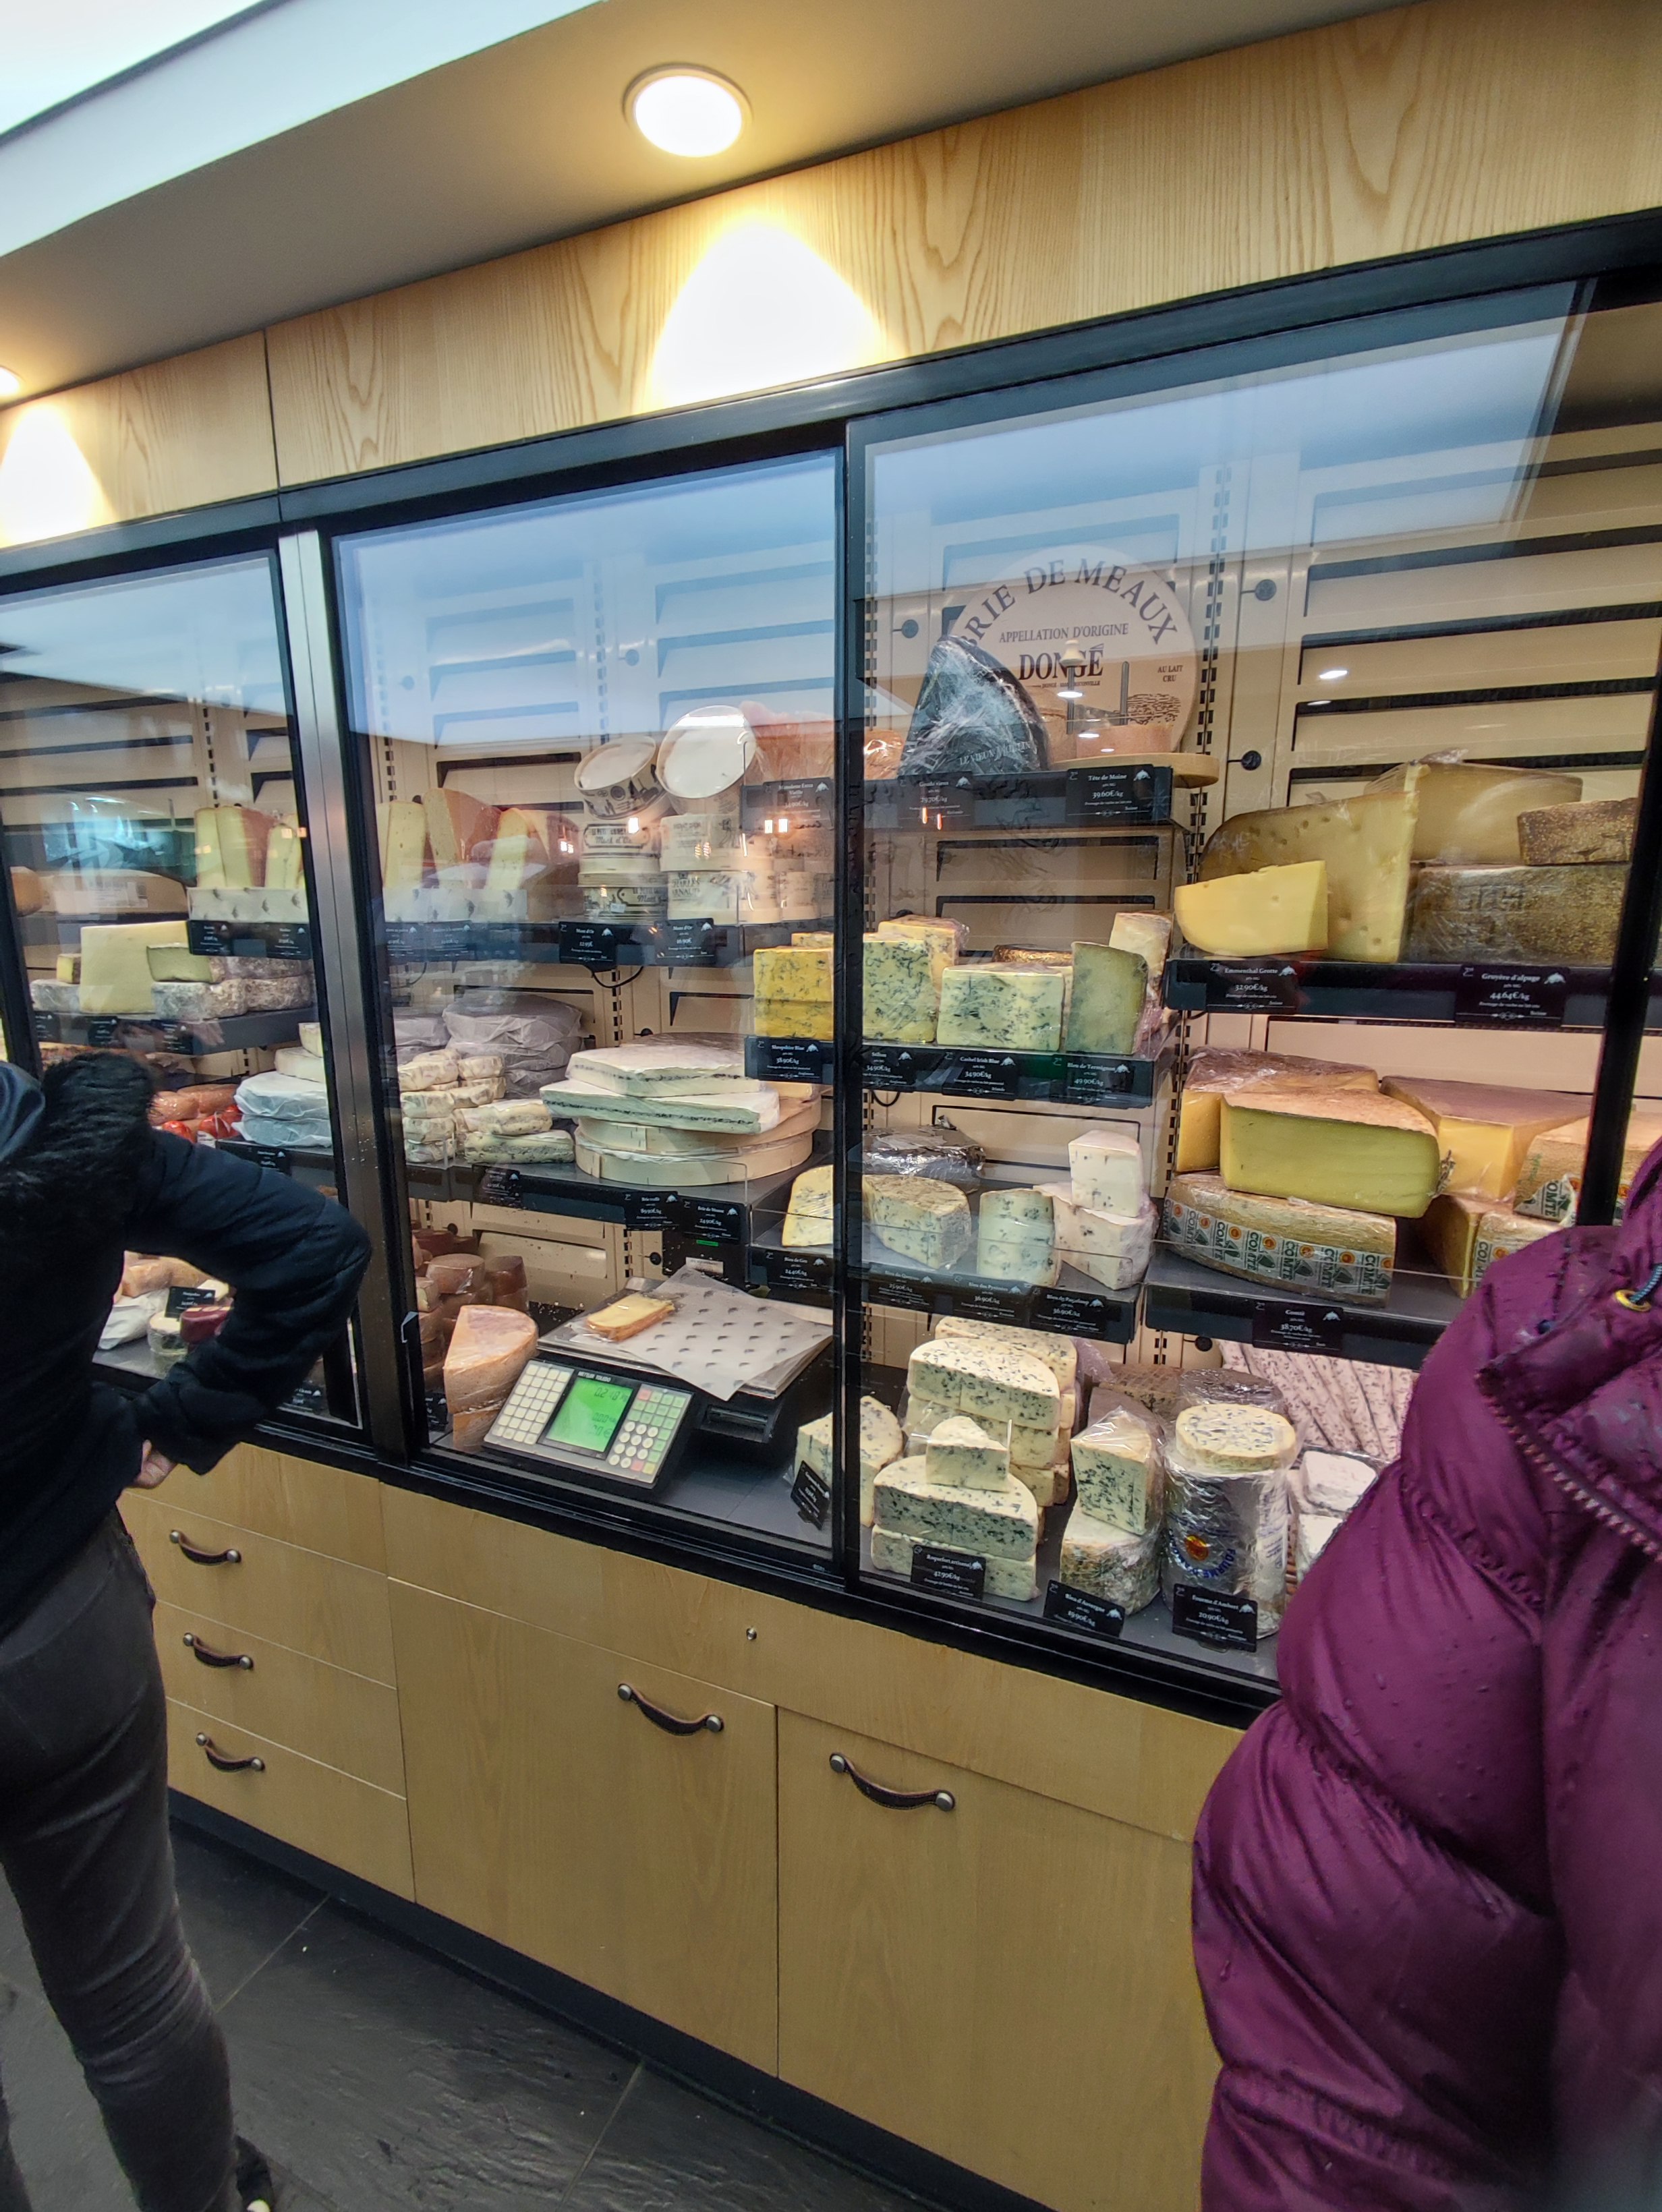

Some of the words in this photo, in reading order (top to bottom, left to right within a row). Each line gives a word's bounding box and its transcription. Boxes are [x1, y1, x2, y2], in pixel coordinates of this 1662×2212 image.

[1024, 559, 1066, 594] DE
[1074, 558, 1178, 645] MEAUX
[1000, 627, 1069, 643] APPELLATION
[1073, 622, 1129, 638] D'ORIGINE
[1157, 666, 1168, 674] AU
[1169, 664, 1184, 673] LAIT
[1162, 674, 1177, 682] CRU
[1511, 973, 1541, 982] d'alpage
[1545, 1180, 1558, 1217] OMTE
